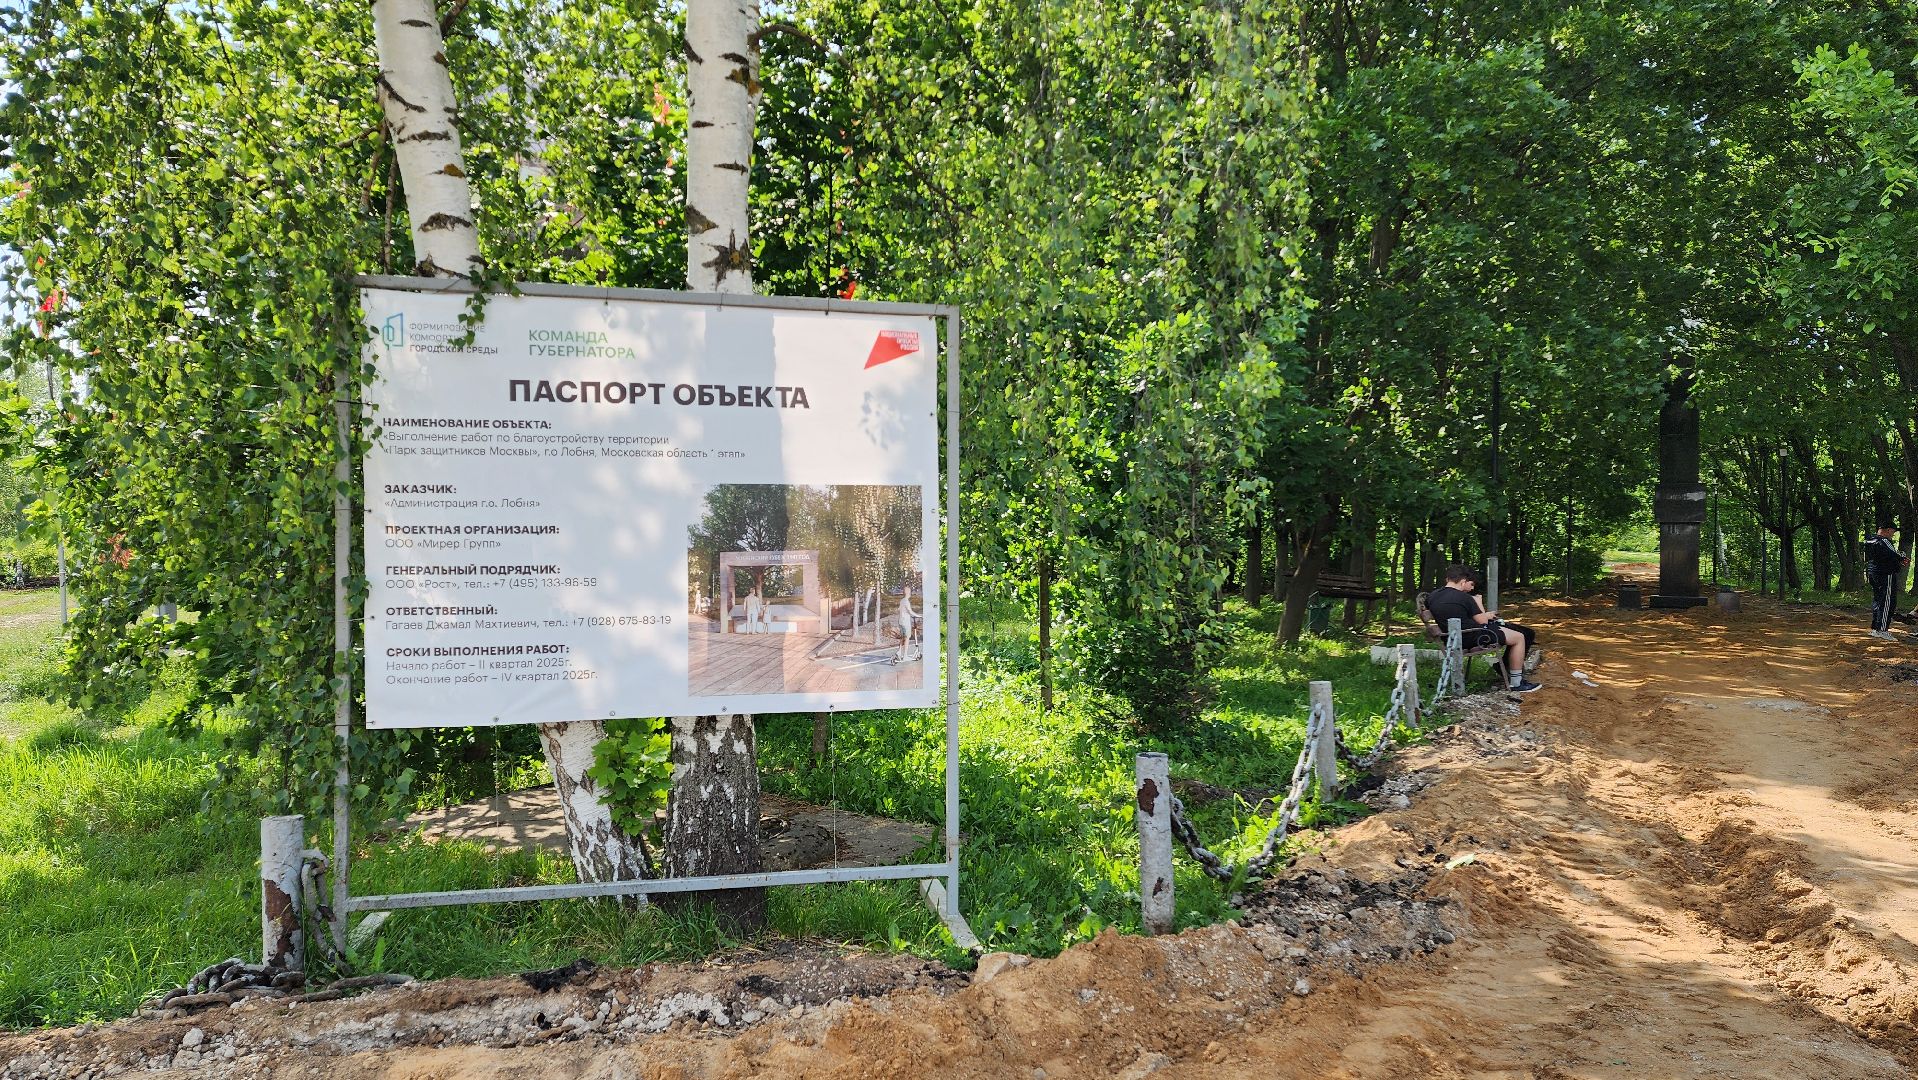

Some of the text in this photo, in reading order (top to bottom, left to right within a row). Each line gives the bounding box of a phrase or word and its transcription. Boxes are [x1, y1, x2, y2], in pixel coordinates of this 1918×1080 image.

[528, 329, 609, 344] КОМАНДА
[466, 346, 498, 355] СРЕДЫ
[528, 344, 636, 360] ГУБЕРНАТОРА
[509, 379, 811, 409] ПАСПОРТ ОБЪЕКТА
[383, 417, 552, 430] НАИМЕНОВАНИЕ ОБЪЕКТА:
[461, 432, 492, 444] работ
[496, 434, 510, 443] по
[513, 432, 604, 445] благоустройству
[607, 434, 670, 445] территории
[383, 445, 416, 457] «Парк
[420, 446, 486, 457] защитников
[489, 446, 541, 457] Москвы»,
[560, 446, 598, 459] Лобня,
[601, 447, 664, 458] Московская
[666, 447, 708, 458] область
[384, 484, 457, 494] ЗАКАЗЧИК:
[384, 498, 478, 509] «Администрация
[500, 497, 540, 508] Лобня»
[385, 525, 560, 535] ПРОЕКТНАЯ ОРГАНИЗАЦИЯ:
[385, 538, 501, 550] ООО «Мирер Групп»
[386, 563, 561, 576] ГЕНЕРАЛЬНЫЙ ПОДРЯДЧИК:
[386, 579, 415, 589] ООО
[418, 579, 460, 590] «Рост»,
[464, 580, 490, 589] тел.:
[492, 578, 505, 588] +7
[509, 577, 539, 589] (495)
[386, 604, 498, 616] ОТВЕТСТВЕННЫЙ:
[386, 615, 672, 630] Гагаев Джамал Махтиевич, тел.: +7 (928) 675-83-19
[386, 644, 570, 658] СРОКИ ВЫПОЛНЕНИЯ РАБОТ:
[386, 661, 429, 671] Начало
[431, 660, 466, 672] работ
[489, 658, 533, 671] квартал
[536, 657, 573, 668] 2025г.
[454, 673, 488, 686] работ
[515, 671, 559, 684] квартал
[562, 669, 598, 681] 2025г.
